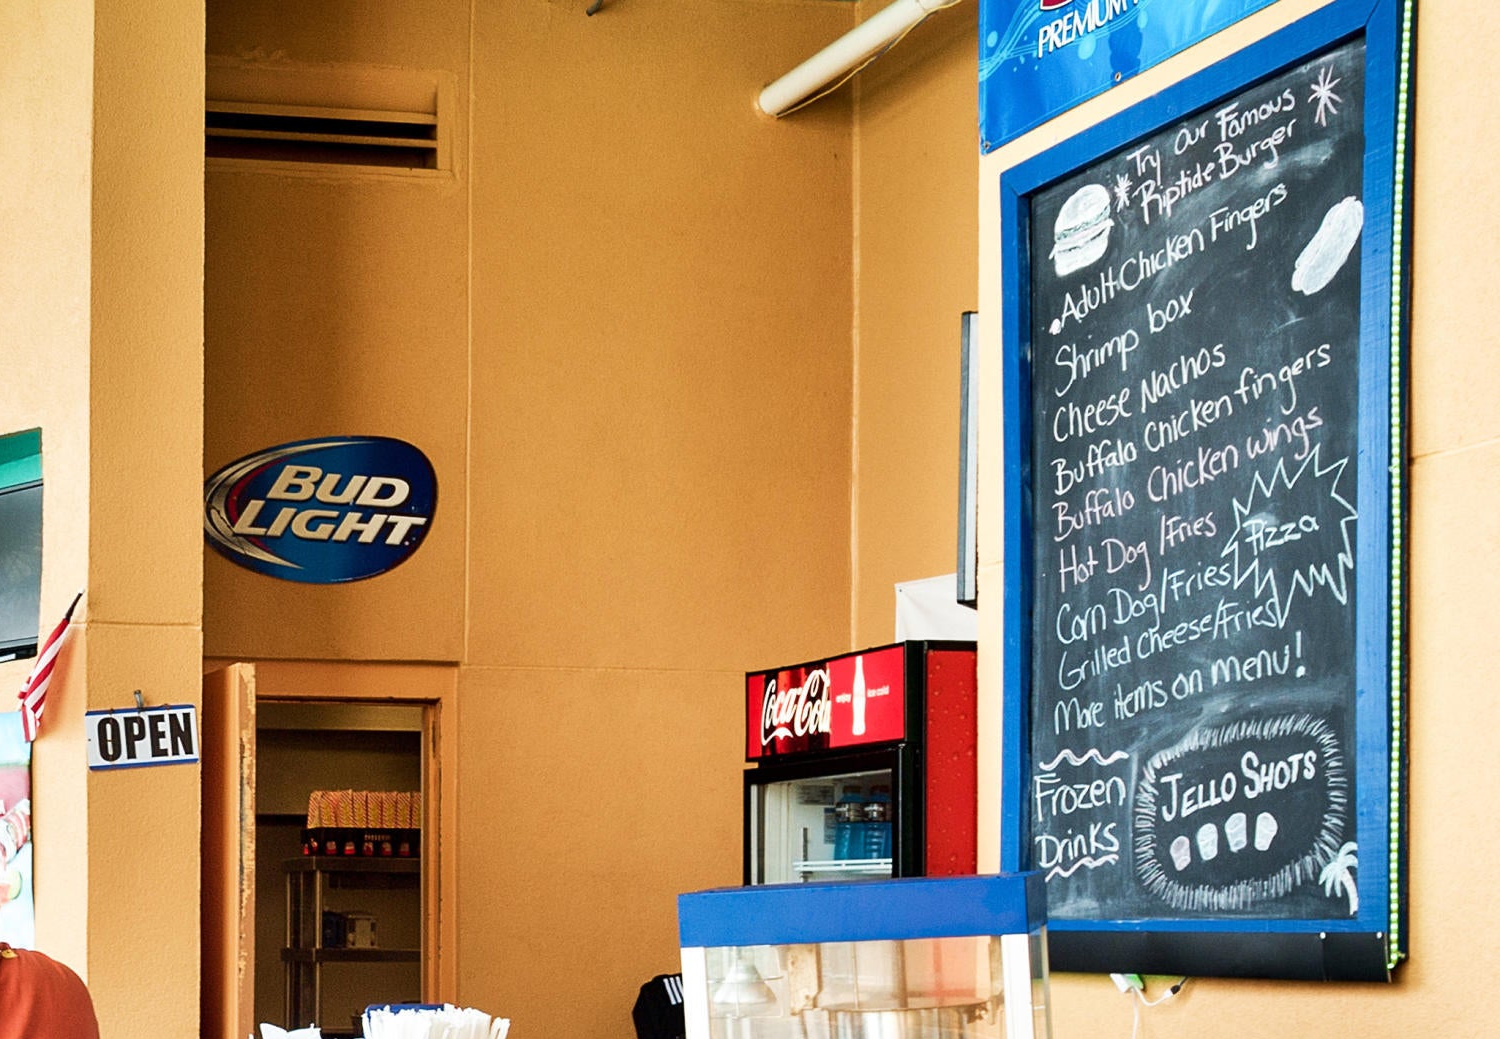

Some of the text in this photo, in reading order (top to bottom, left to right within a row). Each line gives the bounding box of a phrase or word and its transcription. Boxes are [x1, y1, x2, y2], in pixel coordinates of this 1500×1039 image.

[1127, 144, 1161, 185] Try
[1215, 88, 1296, 141] Famous
[1132, 118, 1296, 224] Riptide Burger
[1120, 228, 1204, 291] Chicken
[1209, 183, 1288, 250] Fingers
[1055, 287, 1194, 397] Shrimp box
[1051, 343, 1331, 495] Buffalo Chicken fingers
[1054, 344, 1226, 442] Cheese Nachos
[266, 465, 410, 508] BUD
[1052, 406, 1323, 541] Buffalo Chicken wings
[233, 499, 428, 545] LIGHT
[1242, 514, 1320, 557] Pizza
[1059, 545, 1099, 593] Hot
[1101, 539, 1152, 592] Dog
[1056, 603, 1106, 644] Corn
[1058, 636, 1131, 690] Grilled
[1054, 697, 1104, 735] More
[1114, 680, 1168, 720] items
[1171, 670, 1203, 700] on
[97, 712, 194, 762] OPEN
[1034, 773, 1126, 822] Frozen
[1160, 751, 1318, 822] JELLO SHOTS
